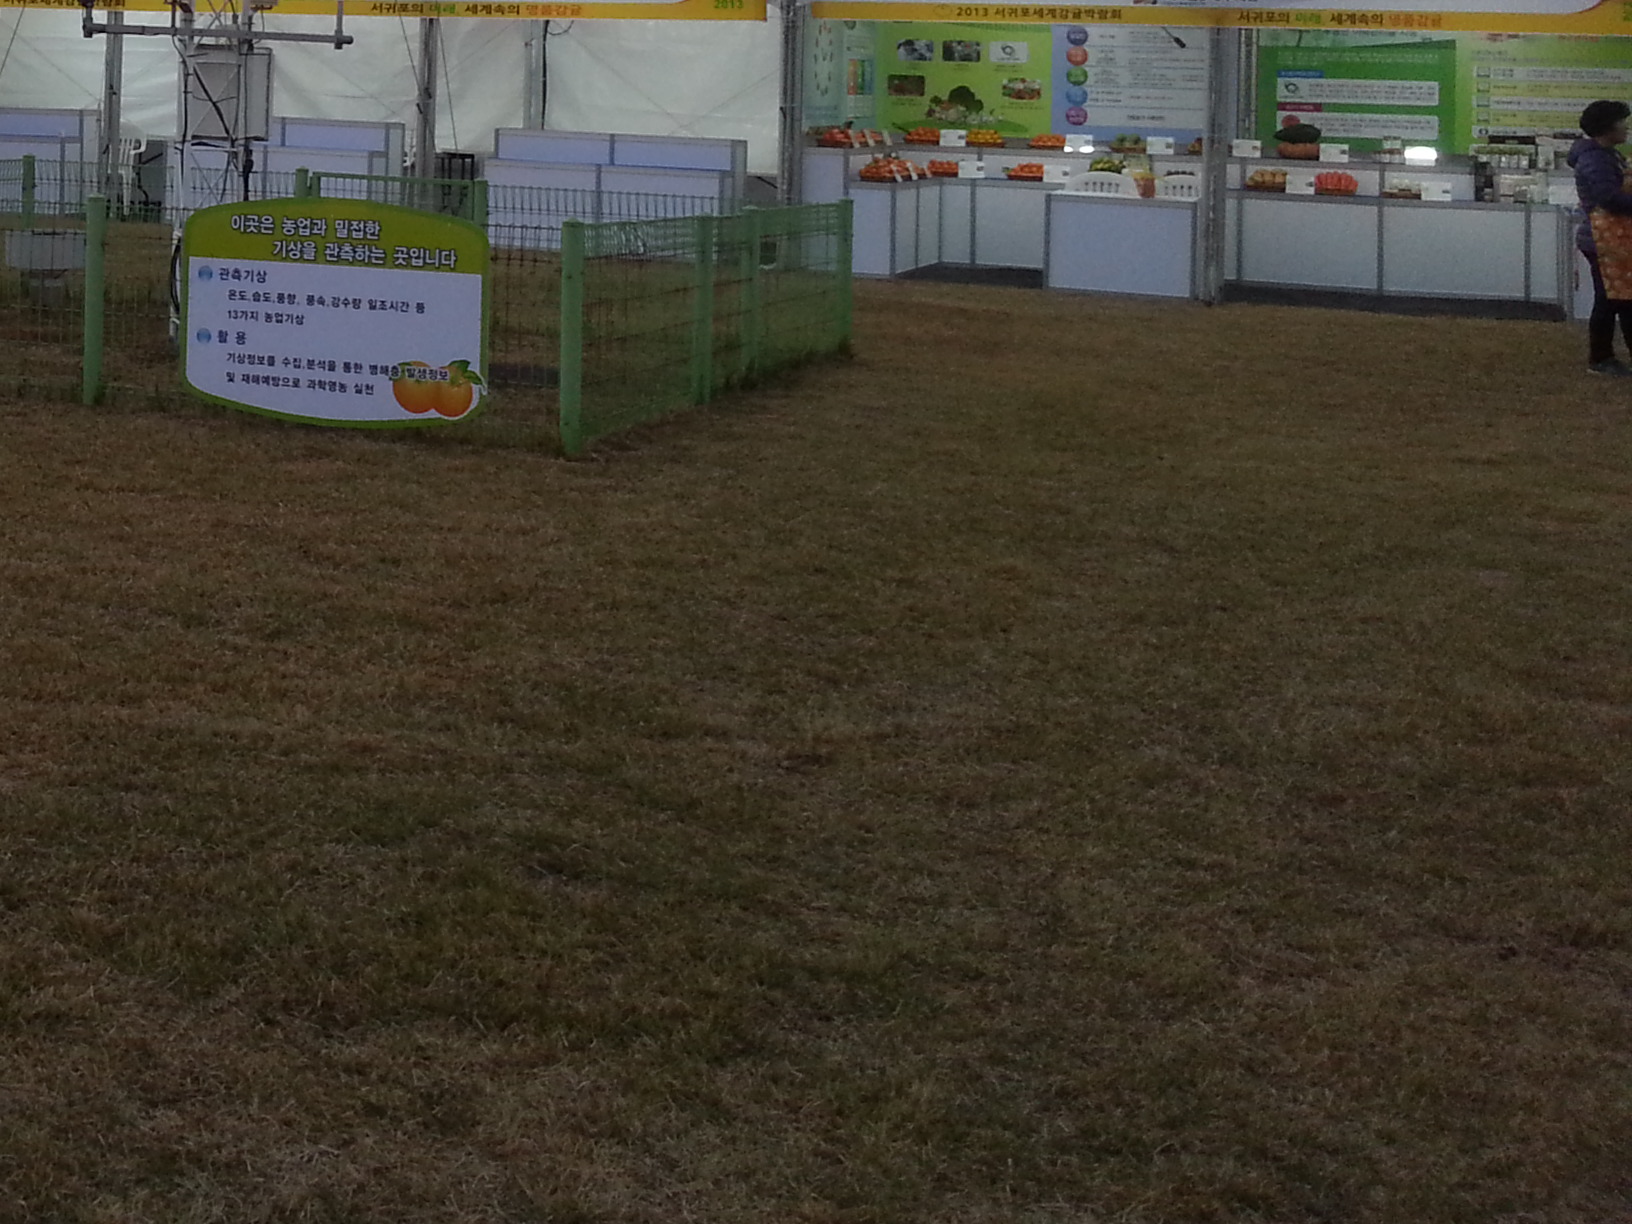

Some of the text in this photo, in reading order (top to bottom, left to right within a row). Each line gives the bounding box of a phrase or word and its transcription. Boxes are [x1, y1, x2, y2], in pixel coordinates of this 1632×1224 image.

[371, 2, 423, 14] 서귀포의
[464, 3, 520, 16] 세계속의
[714, 0, 744, 9] 2013
[956, 6, 1123, 21] 2013 서귀포세계감귤박람회
[1237, 10, 1290, 25] 서귀포의
[1329, 12, 1384, 26] 세계속의
[231, 215, 381, 240] 이곳은 농업과 밀접한
[272, 240, 457, 268] 기상을 관측하는 곳입니다
[219, 268, 268, 284] 관측기상
[368, 298, 410, 314] 일조시간
[415, 302, 426, 314] 등
[227, 309, 305, 326] 13가지 농업기상
[226, 352, 276, 368] 기상정보를
[342, 361, 364, 375] 통한
[369, 364, 401, 378] 병해충
[406, 367, 449, 382] 발생정보
[226, 371, 375, 396] 및 재해예방으로 과학영농 실천
